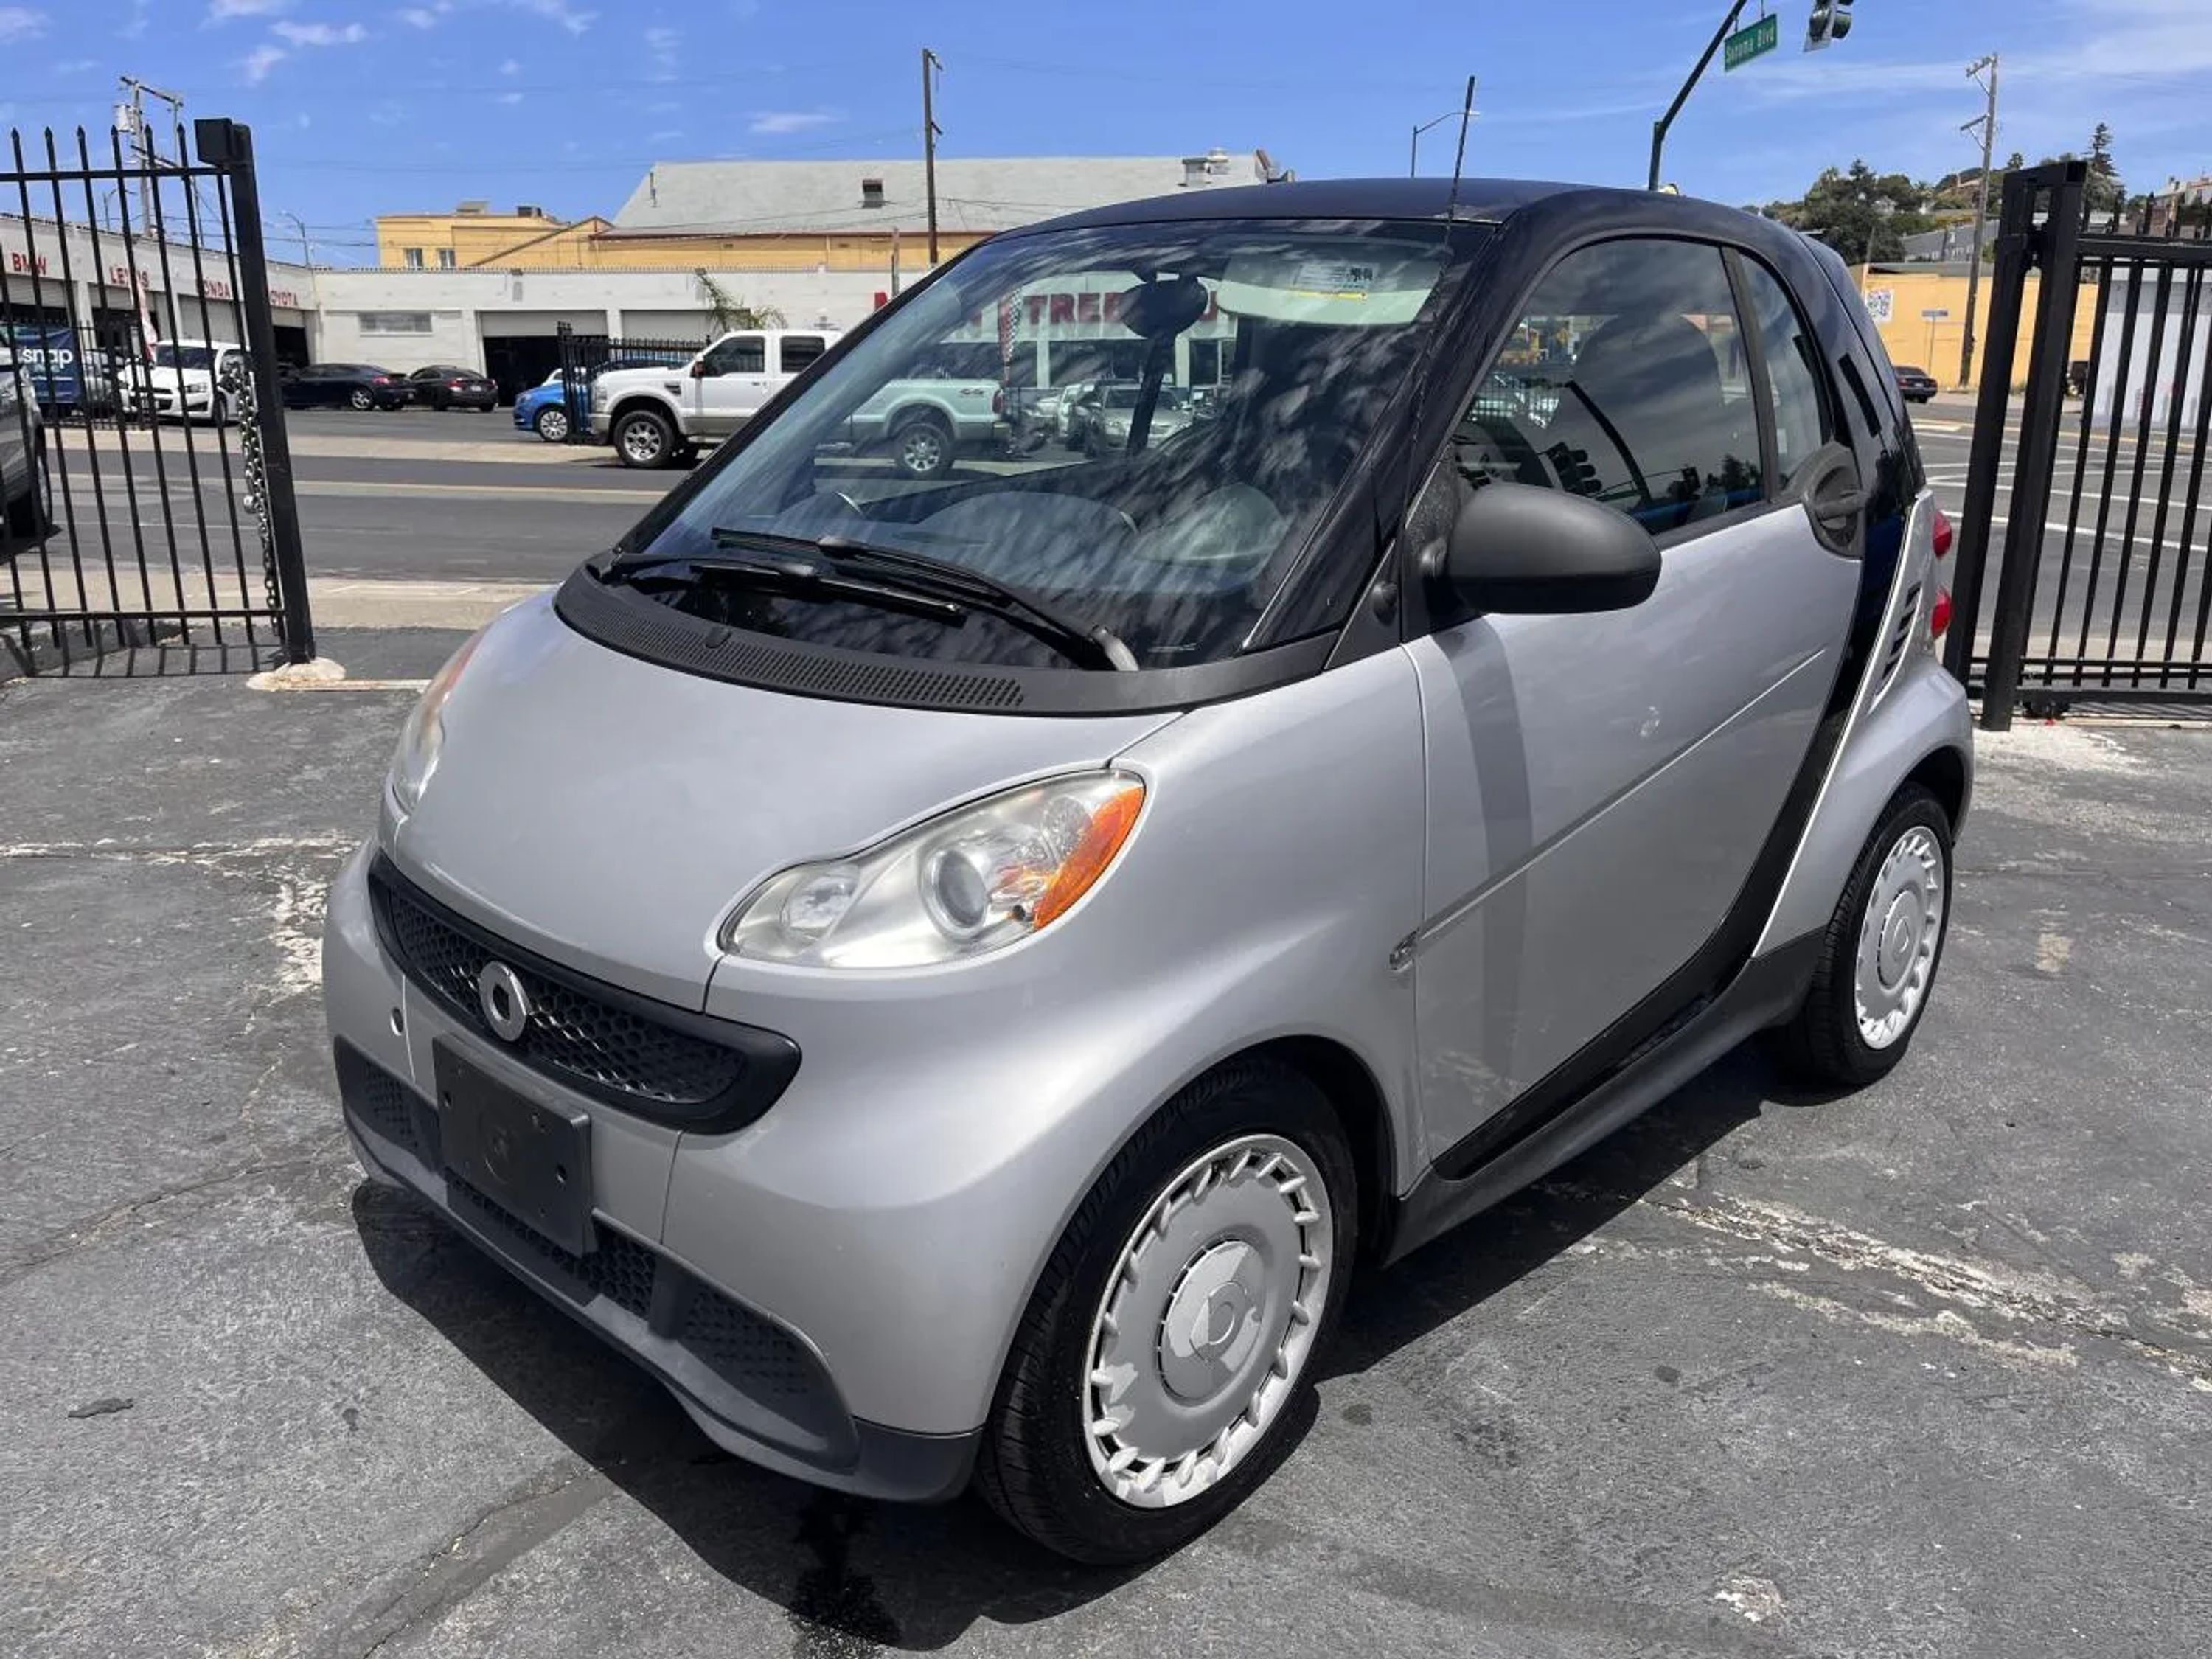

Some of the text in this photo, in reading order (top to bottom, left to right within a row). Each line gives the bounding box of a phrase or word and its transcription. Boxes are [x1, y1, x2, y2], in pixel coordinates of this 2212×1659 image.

[1757, 24, 1774, 49] Blvd
[203, 280, 230, 298] ONDA
[271, 290, 298, 306] OYOTA
[22, 349, 73, 369] snap
